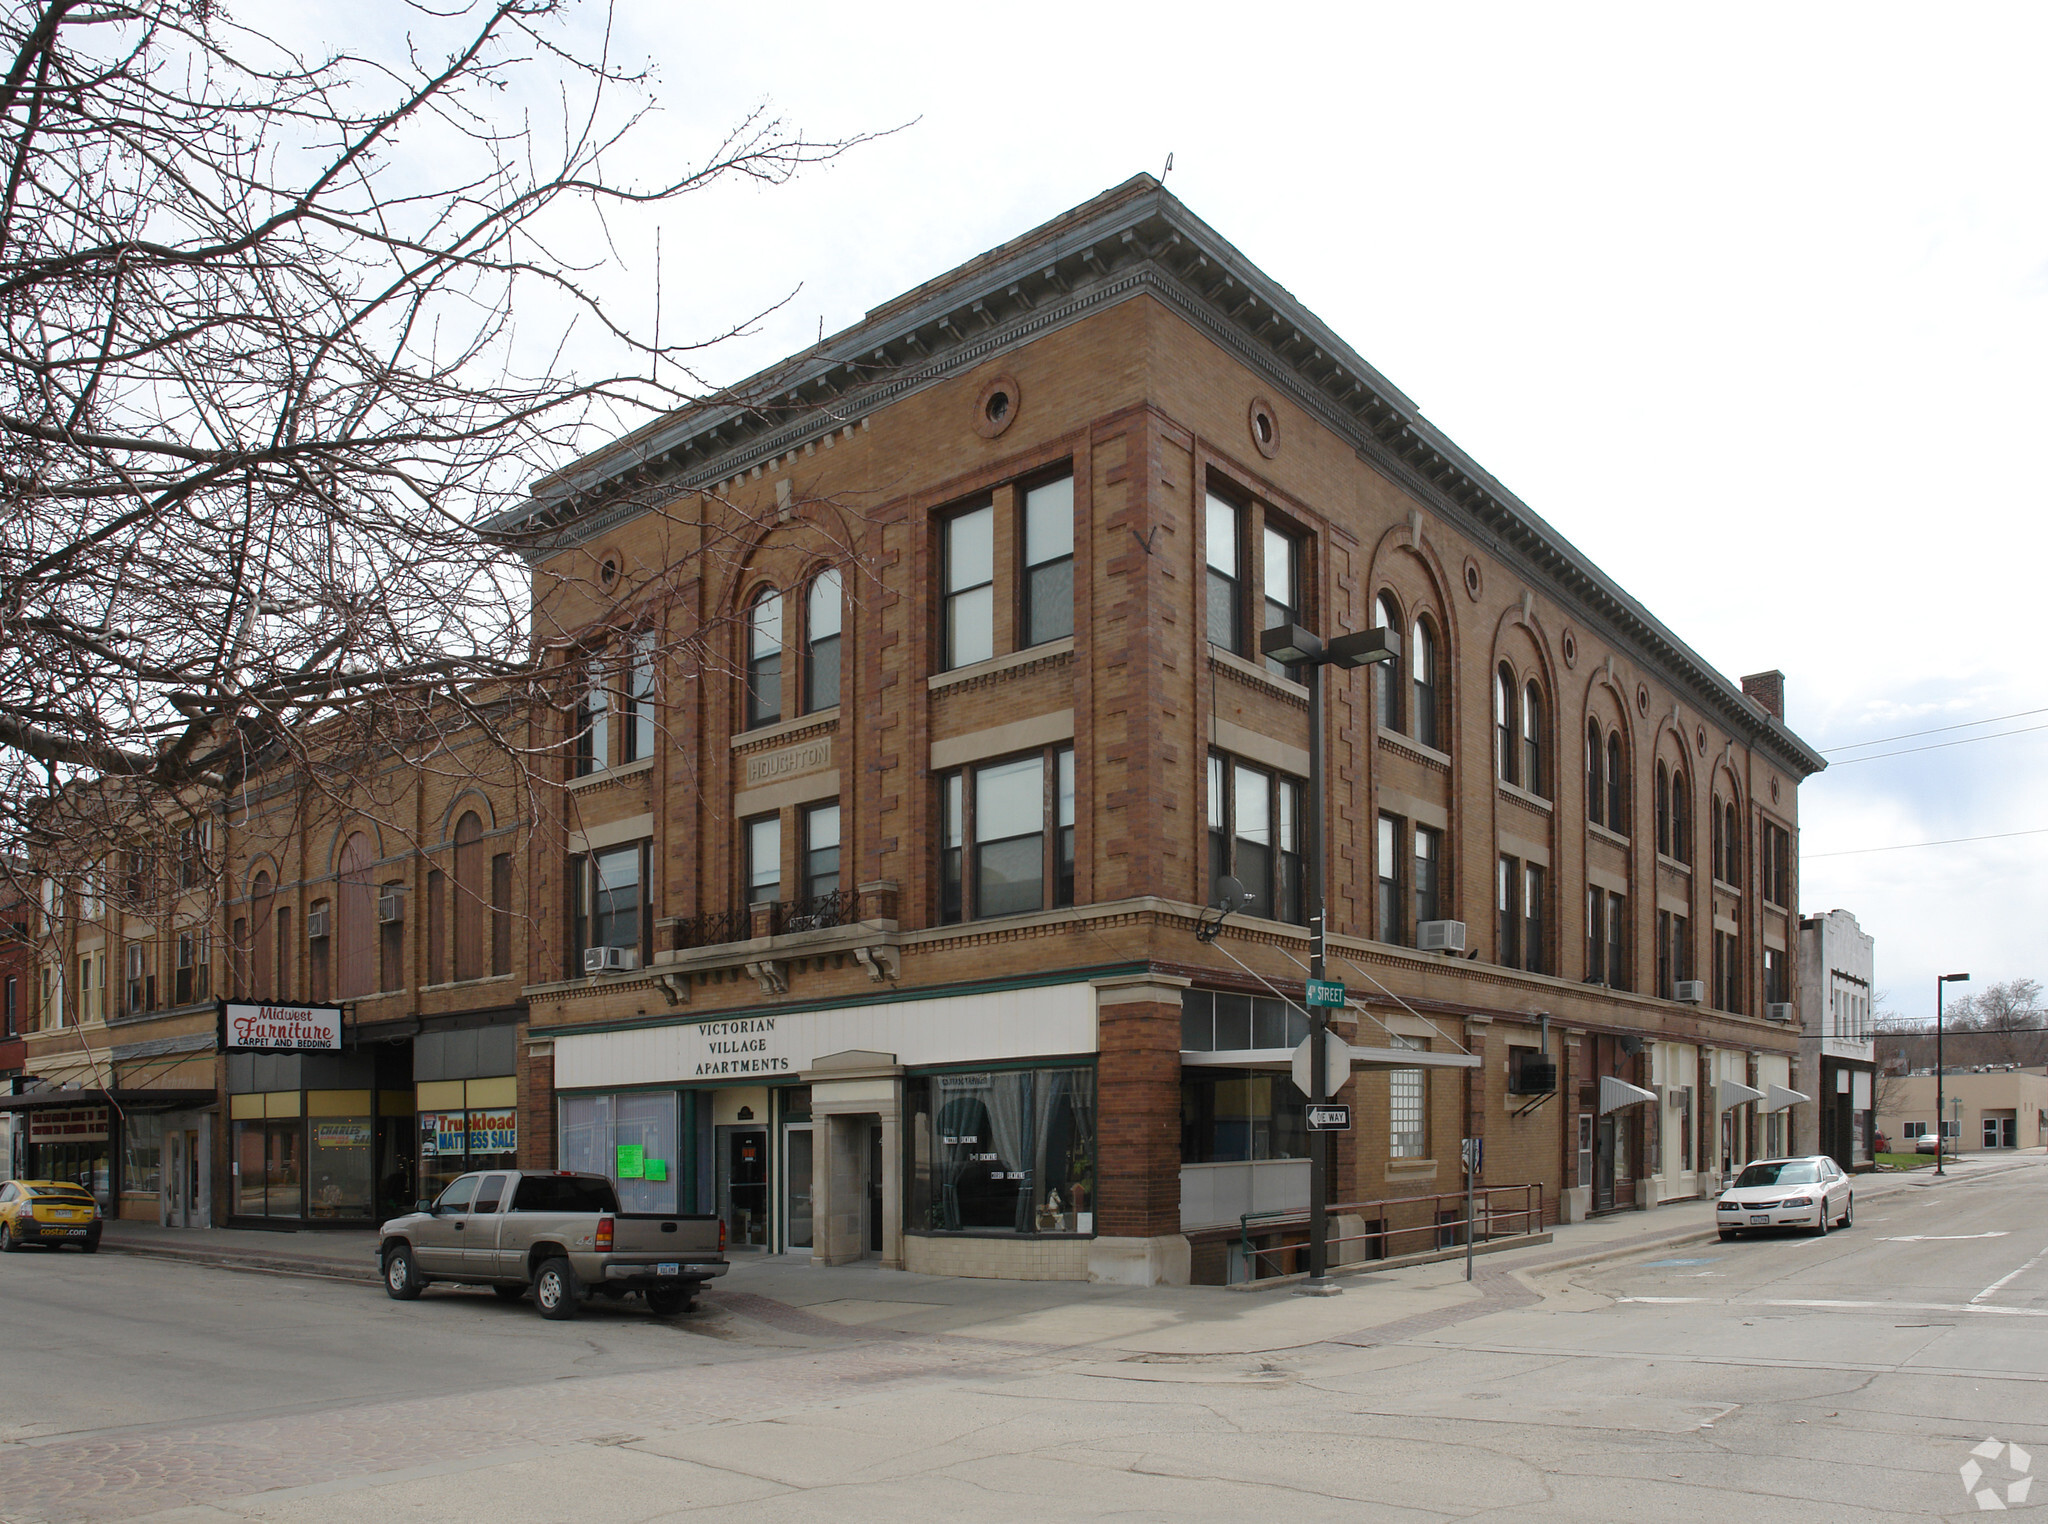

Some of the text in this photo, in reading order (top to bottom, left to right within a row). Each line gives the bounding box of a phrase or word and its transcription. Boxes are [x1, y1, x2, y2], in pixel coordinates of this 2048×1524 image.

[751, 745, 828, 779] HOUGHTON
[1317, 986, 1343, 1003] STREET
[259, 1006, 313, 1021] Midwest
[233, 1016, 334, 1040] Furniture
[699, 1018, 775, 1036] VICTORIAN
[237, 1037, 331, 1048] CARPET AND BEDDING
[709, 1038, 766, 1054] VILLAGE
[695, 1057, 789, 1075] APARTMENTS
[438, 1111, 516, 1132] Trukload
[1328, 1112, 1344, 1122] WAY
[320, 1125, 362, 1135] CHARLES
[438, 1129, 516, 1149] MATTESS SALE
[40, 1228, 87, 1236] costar.com
